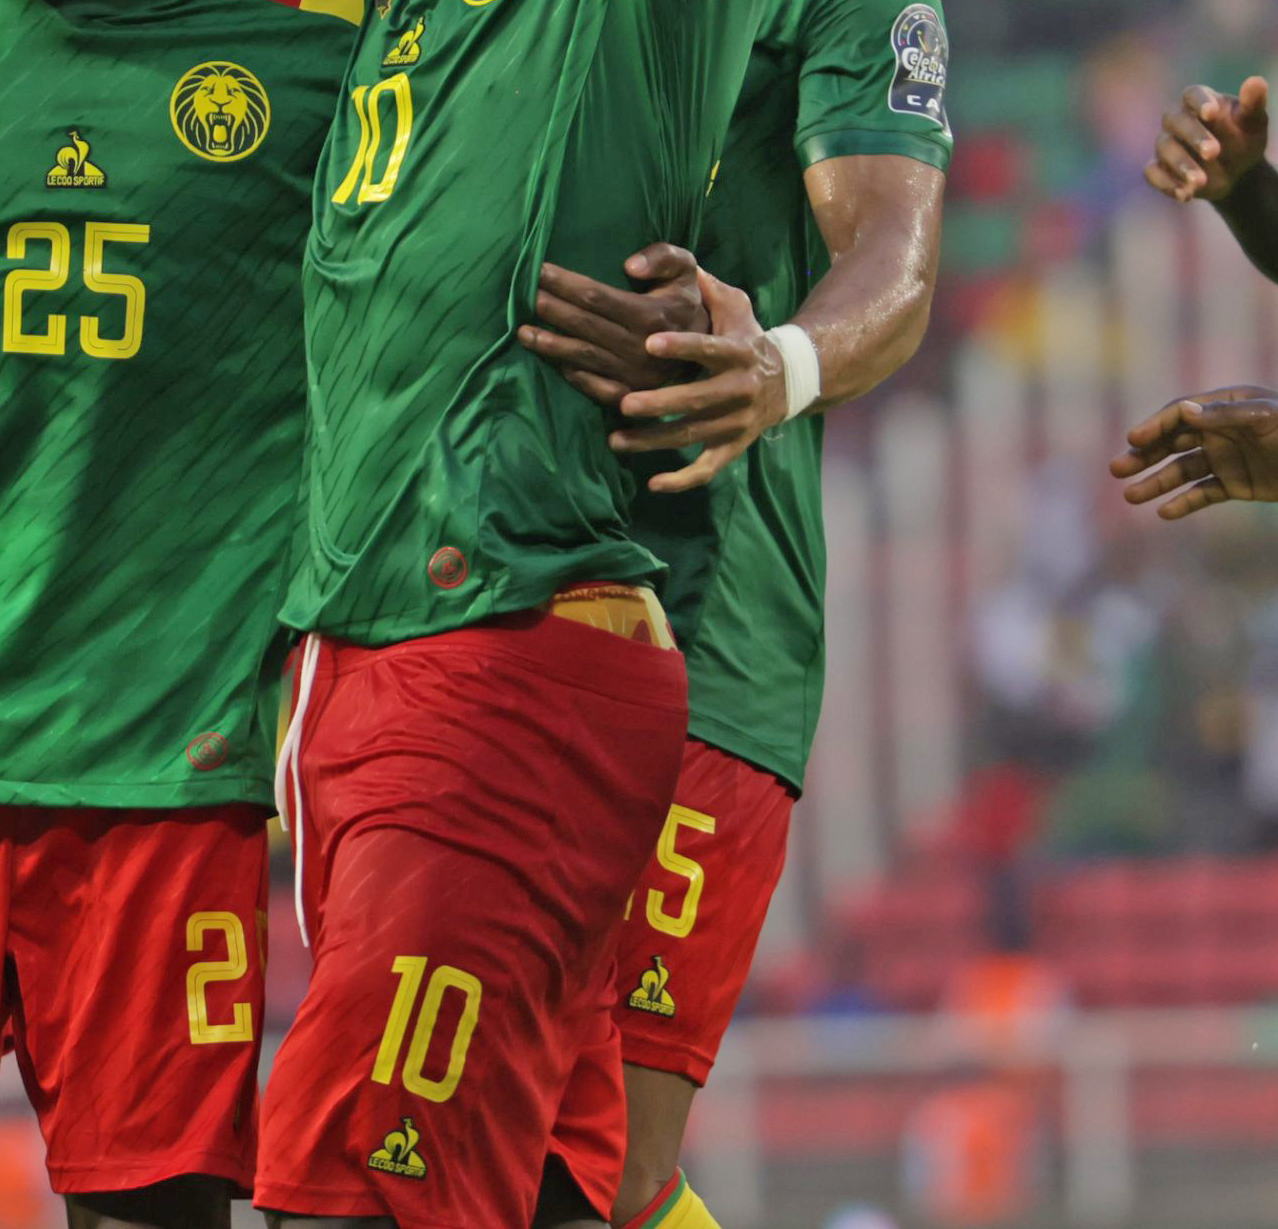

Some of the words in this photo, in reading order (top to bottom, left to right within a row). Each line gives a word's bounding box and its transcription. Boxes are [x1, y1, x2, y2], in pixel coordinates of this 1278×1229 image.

[47, 175, 56, 185] LE
[73, 176, 104, 186] SPORTIF
[331, 72, 413, 205] 10
[3, 221, 150, 359] 25
[625, 803, 716, 938] 5
[186, 911, 268, 1044] 2
[370, 955, 482, 1103] 10
